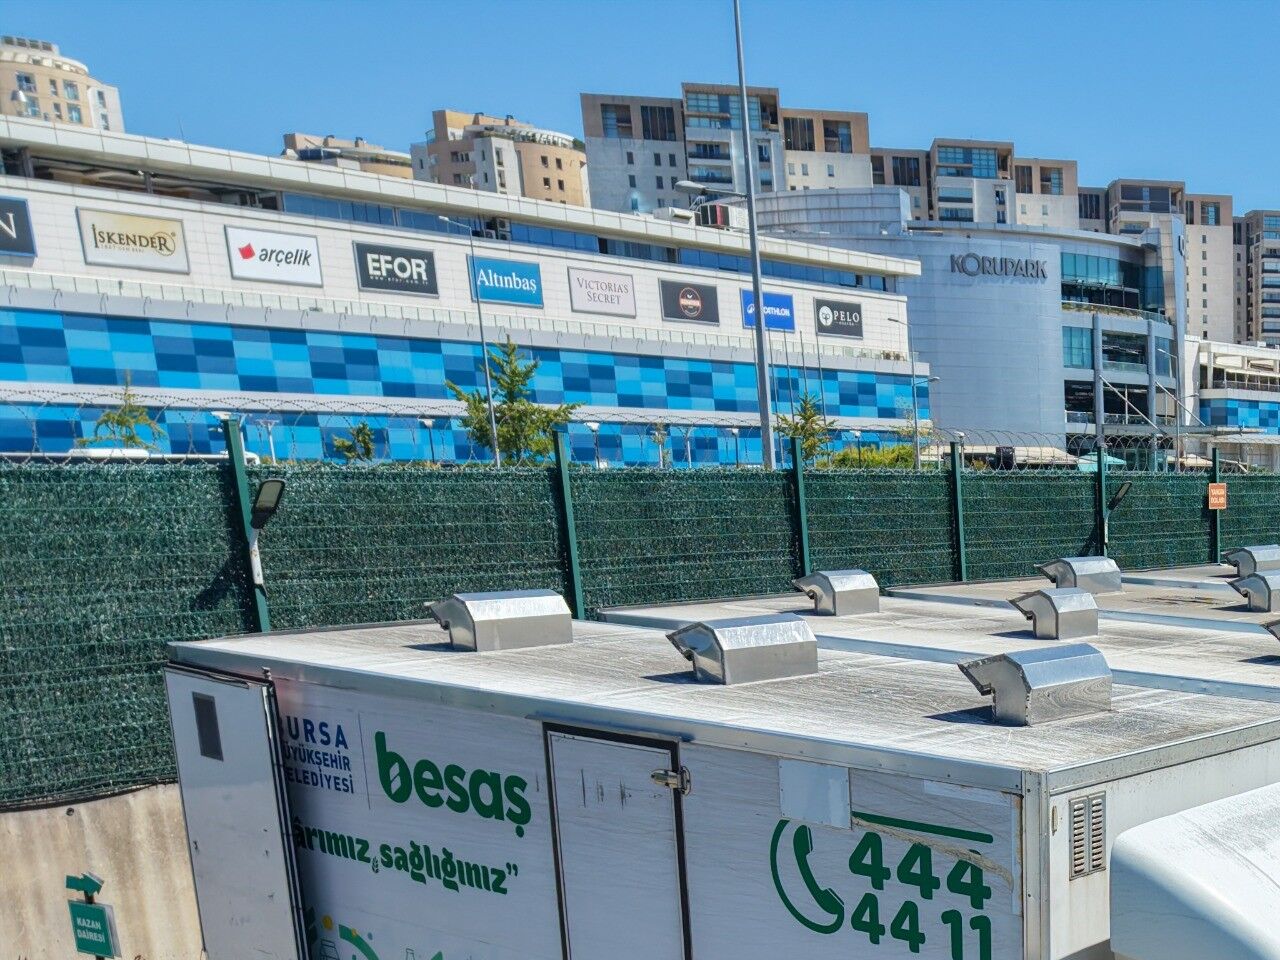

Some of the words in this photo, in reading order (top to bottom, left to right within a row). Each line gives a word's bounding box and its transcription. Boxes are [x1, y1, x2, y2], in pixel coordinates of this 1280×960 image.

[258, 248, 313, 267] arçelik
[367, 253, 428, 280] EFOR
[950, 252, 1048, 279] KORUPARK
[477, 269, 537, 294] Altınbaş
[586, 292, 621, 305] SECRET
[833, 310, 860, 323] PELO
[280, 715, 349, 750] URSA
[375, 731, 532, 838] besaş
[849, 831, 992, 910] 444
[76, 917, 101, 930] KAZAN
[850, 892, 926, 954] 44
